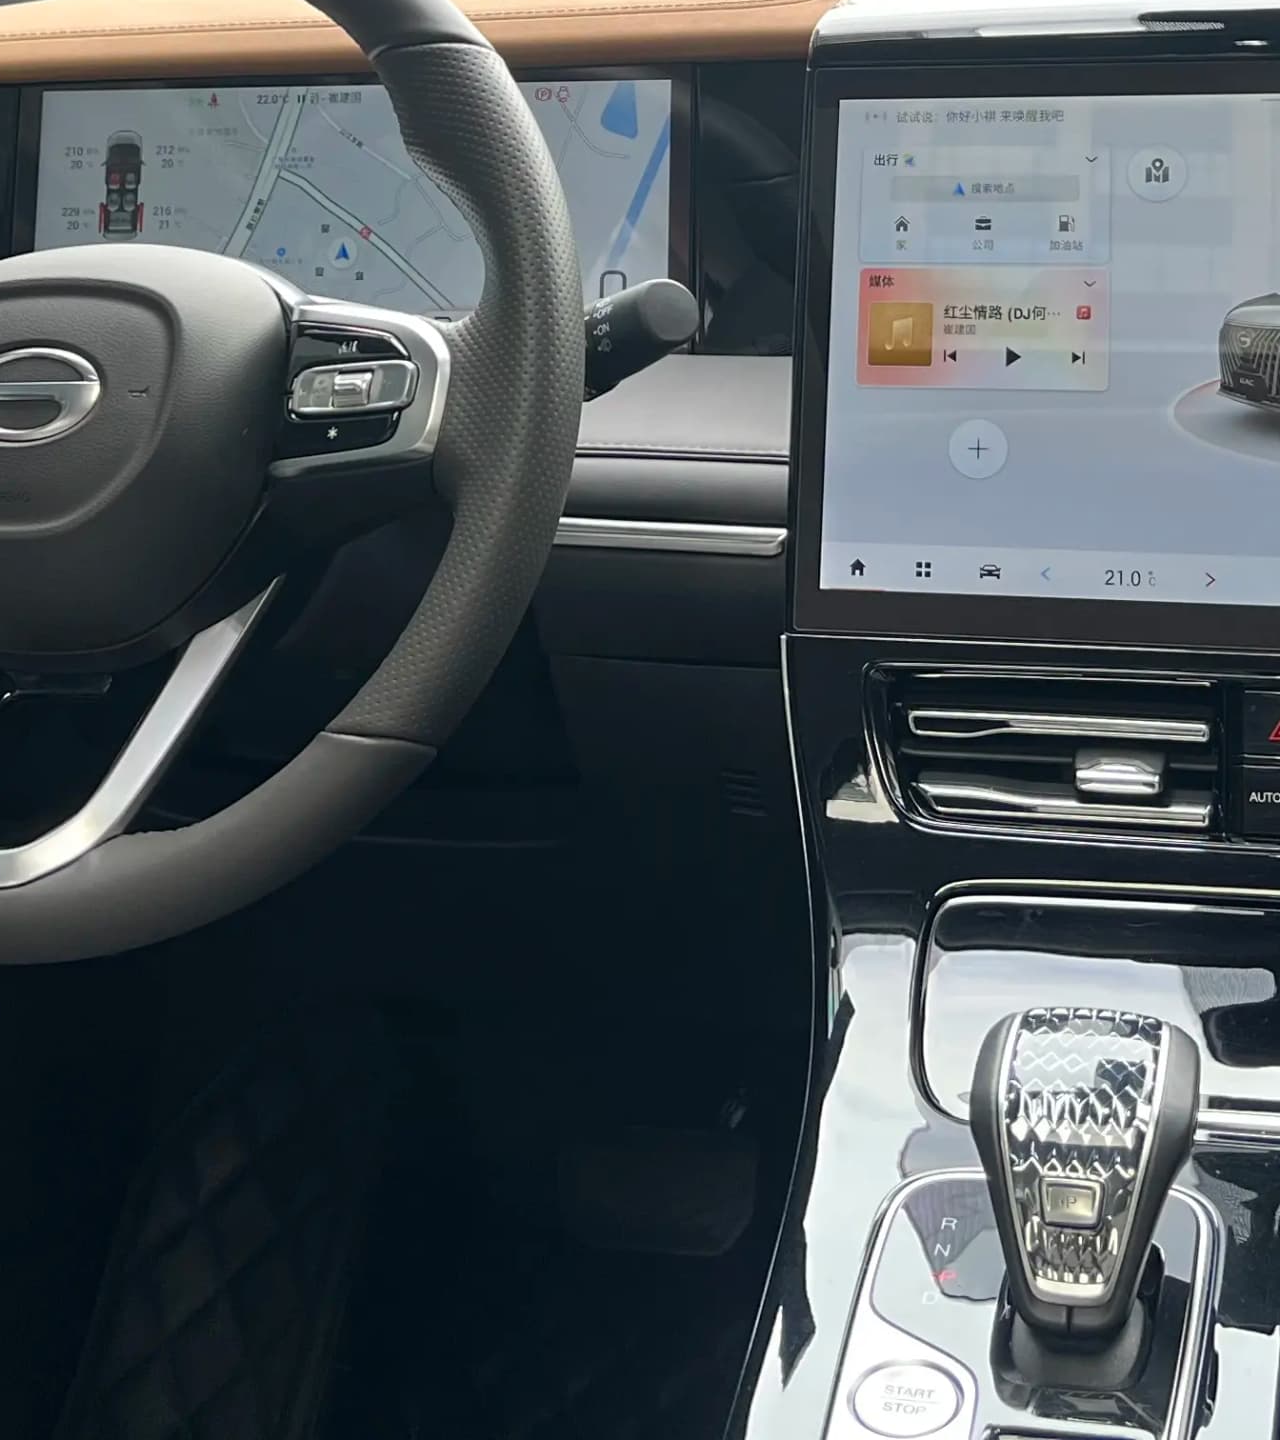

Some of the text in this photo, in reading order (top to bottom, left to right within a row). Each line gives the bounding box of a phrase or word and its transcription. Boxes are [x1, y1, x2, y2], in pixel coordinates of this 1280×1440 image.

[874, 153, 898, 167] 出行
[973, 240, 994, 251] 公司
[1049, 240, 1083, 252] 加油站
[869, 275, 894, 288] 媒体
[943, 304, 1002, 320] 红尘情路
[1104, 569, 1141, 587] 21.0
[941, 1218, 958, 1230] R
[934, 1244, 951, 1257] N
[884, 1384, 936, 1399] START
[882, 1401, 927, 1415] STOP
